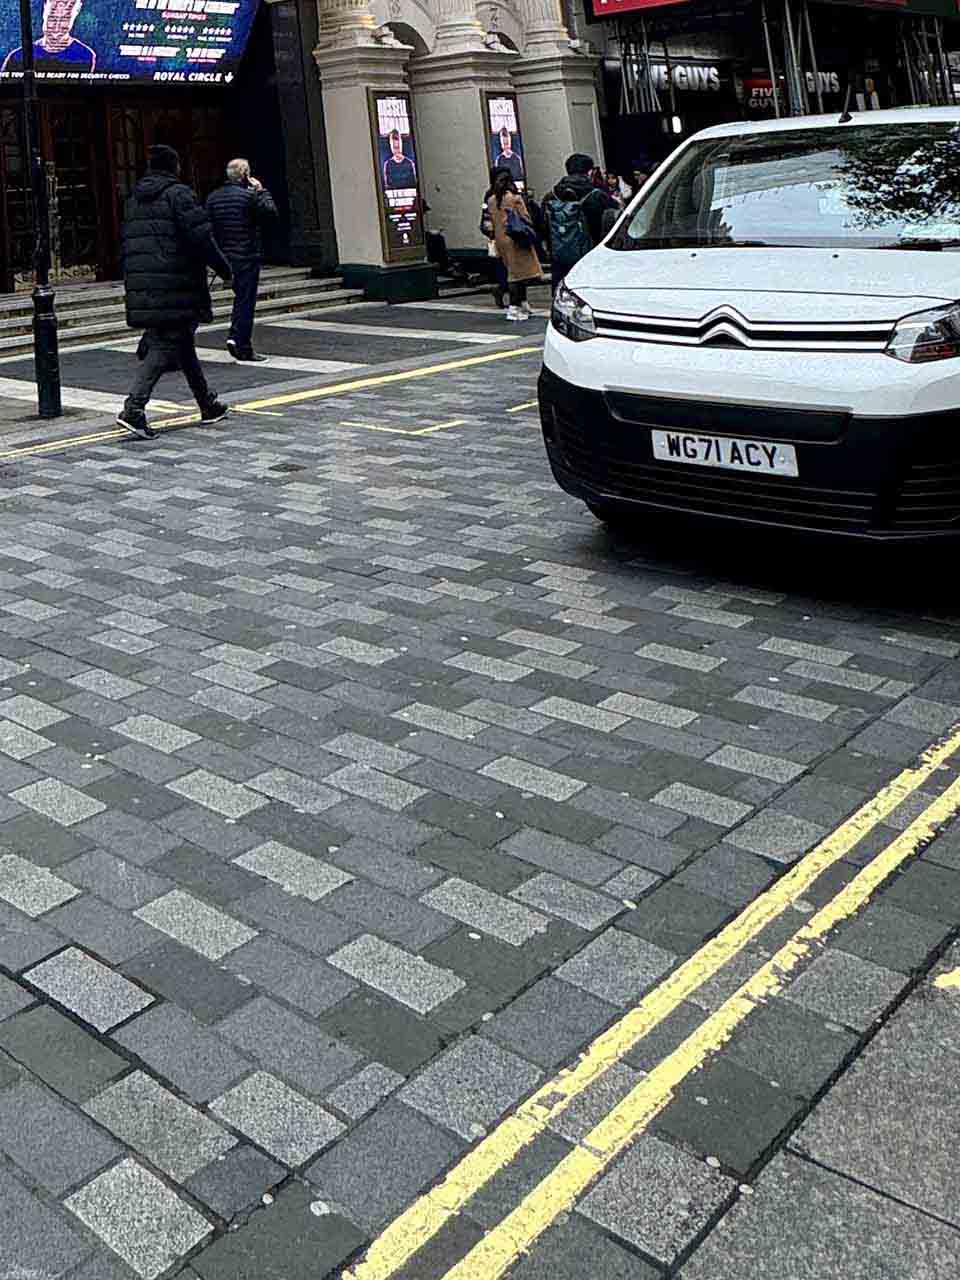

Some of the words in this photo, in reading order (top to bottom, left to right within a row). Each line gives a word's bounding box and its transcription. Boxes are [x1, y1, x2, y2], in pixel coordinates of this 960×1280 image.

[153, 71, 187, 81] ROYAL
[188, 72, 223, 82] CIRCLE
[666, 433, 722, 462] WG71
[730, 441, 778, 469] ACY
